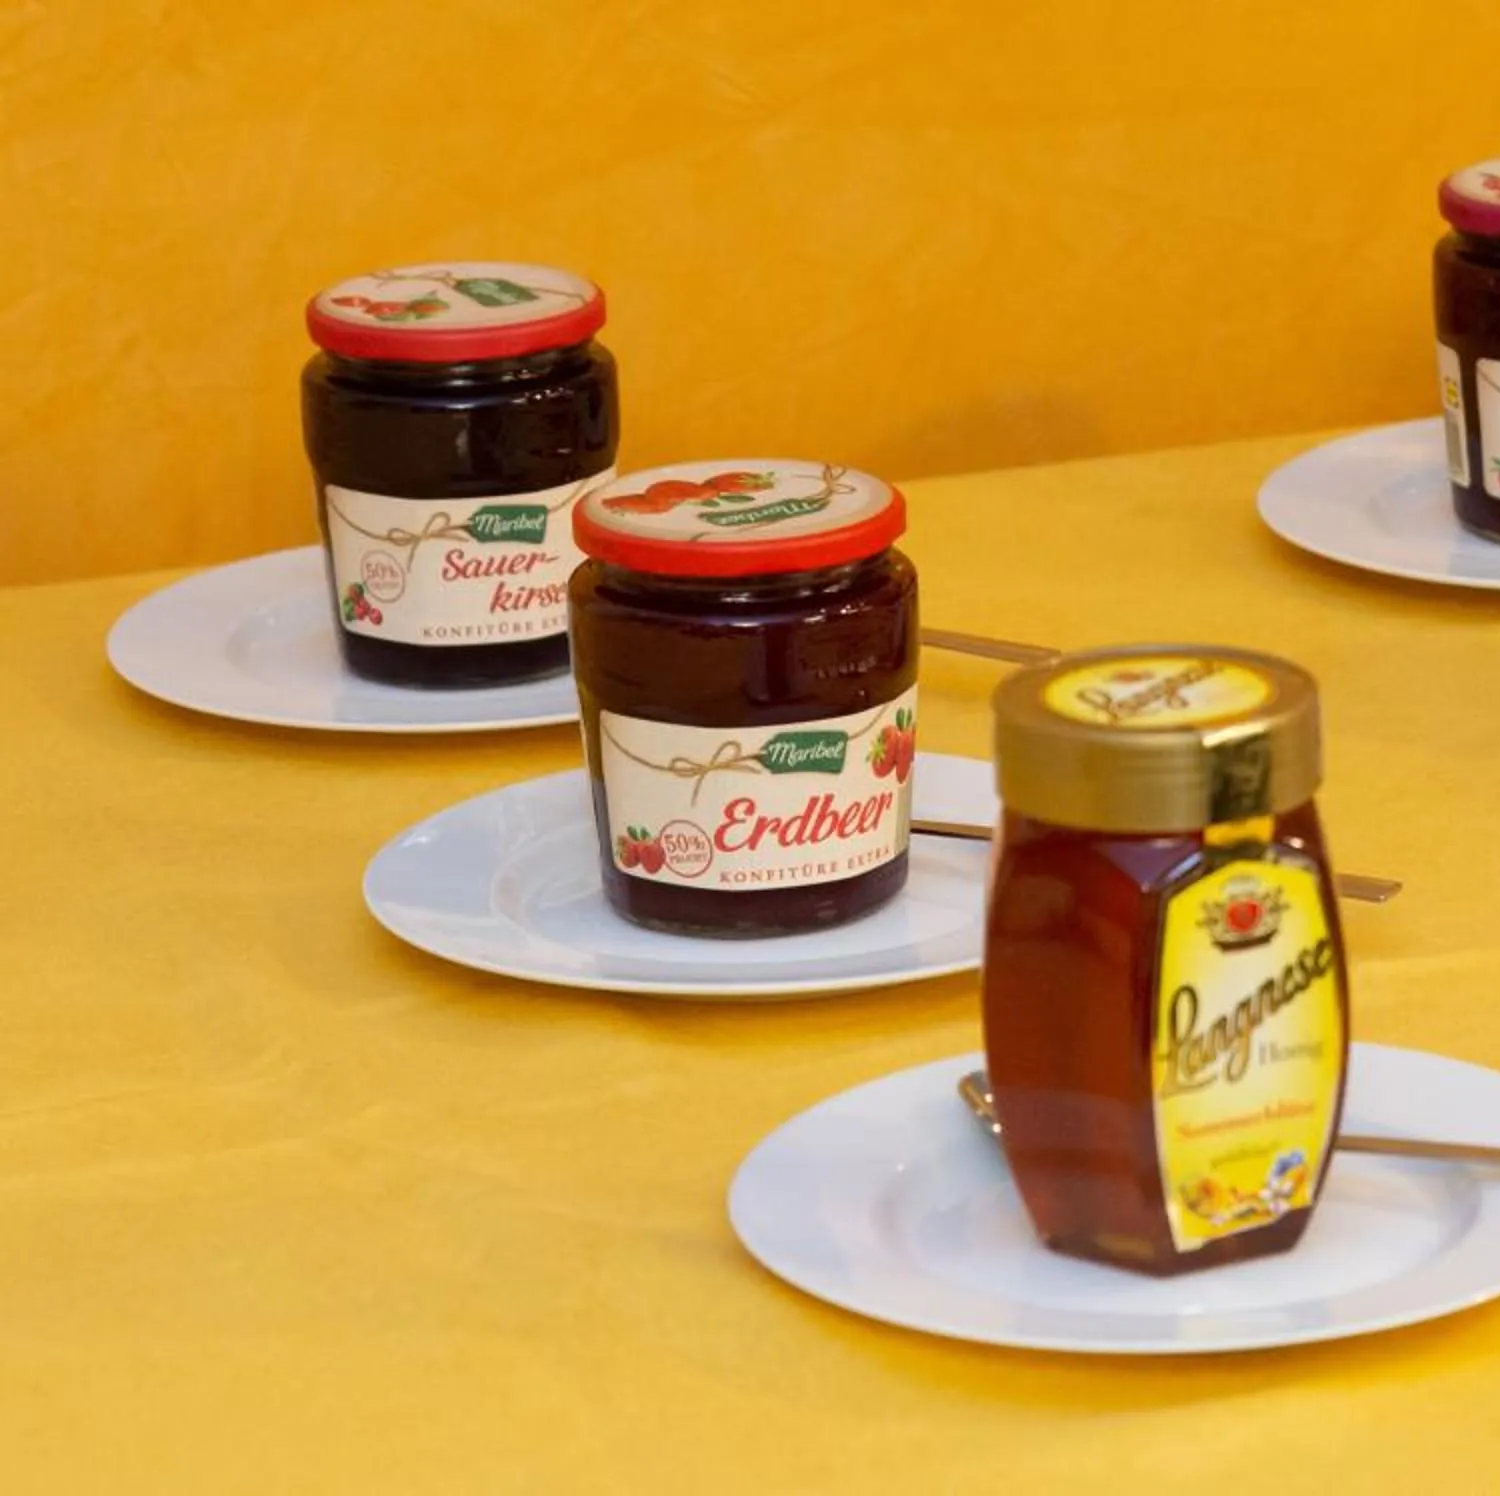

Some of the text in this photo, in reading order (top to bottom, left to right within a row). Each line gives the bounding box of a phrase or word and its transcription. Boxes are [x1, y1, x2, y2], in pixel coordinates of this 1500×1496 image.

[474, 512, 545, 534] Maribel
[366, 559, 399, 580] 50%
[441, 548, 559, 581] Sauer-
[489, 580, 568, 615] kirsc
[423, 612, 568, 639] KONFITÜRE EXT
[767, 739, 845, 767] Maribel
[713, 791, 893, 852] Erdbeer
[663, 830, 706, 854] 50%
[719, 859, 838, 884] KONFITÜRE
[1156, 936, 1333, 1097] Langnese
